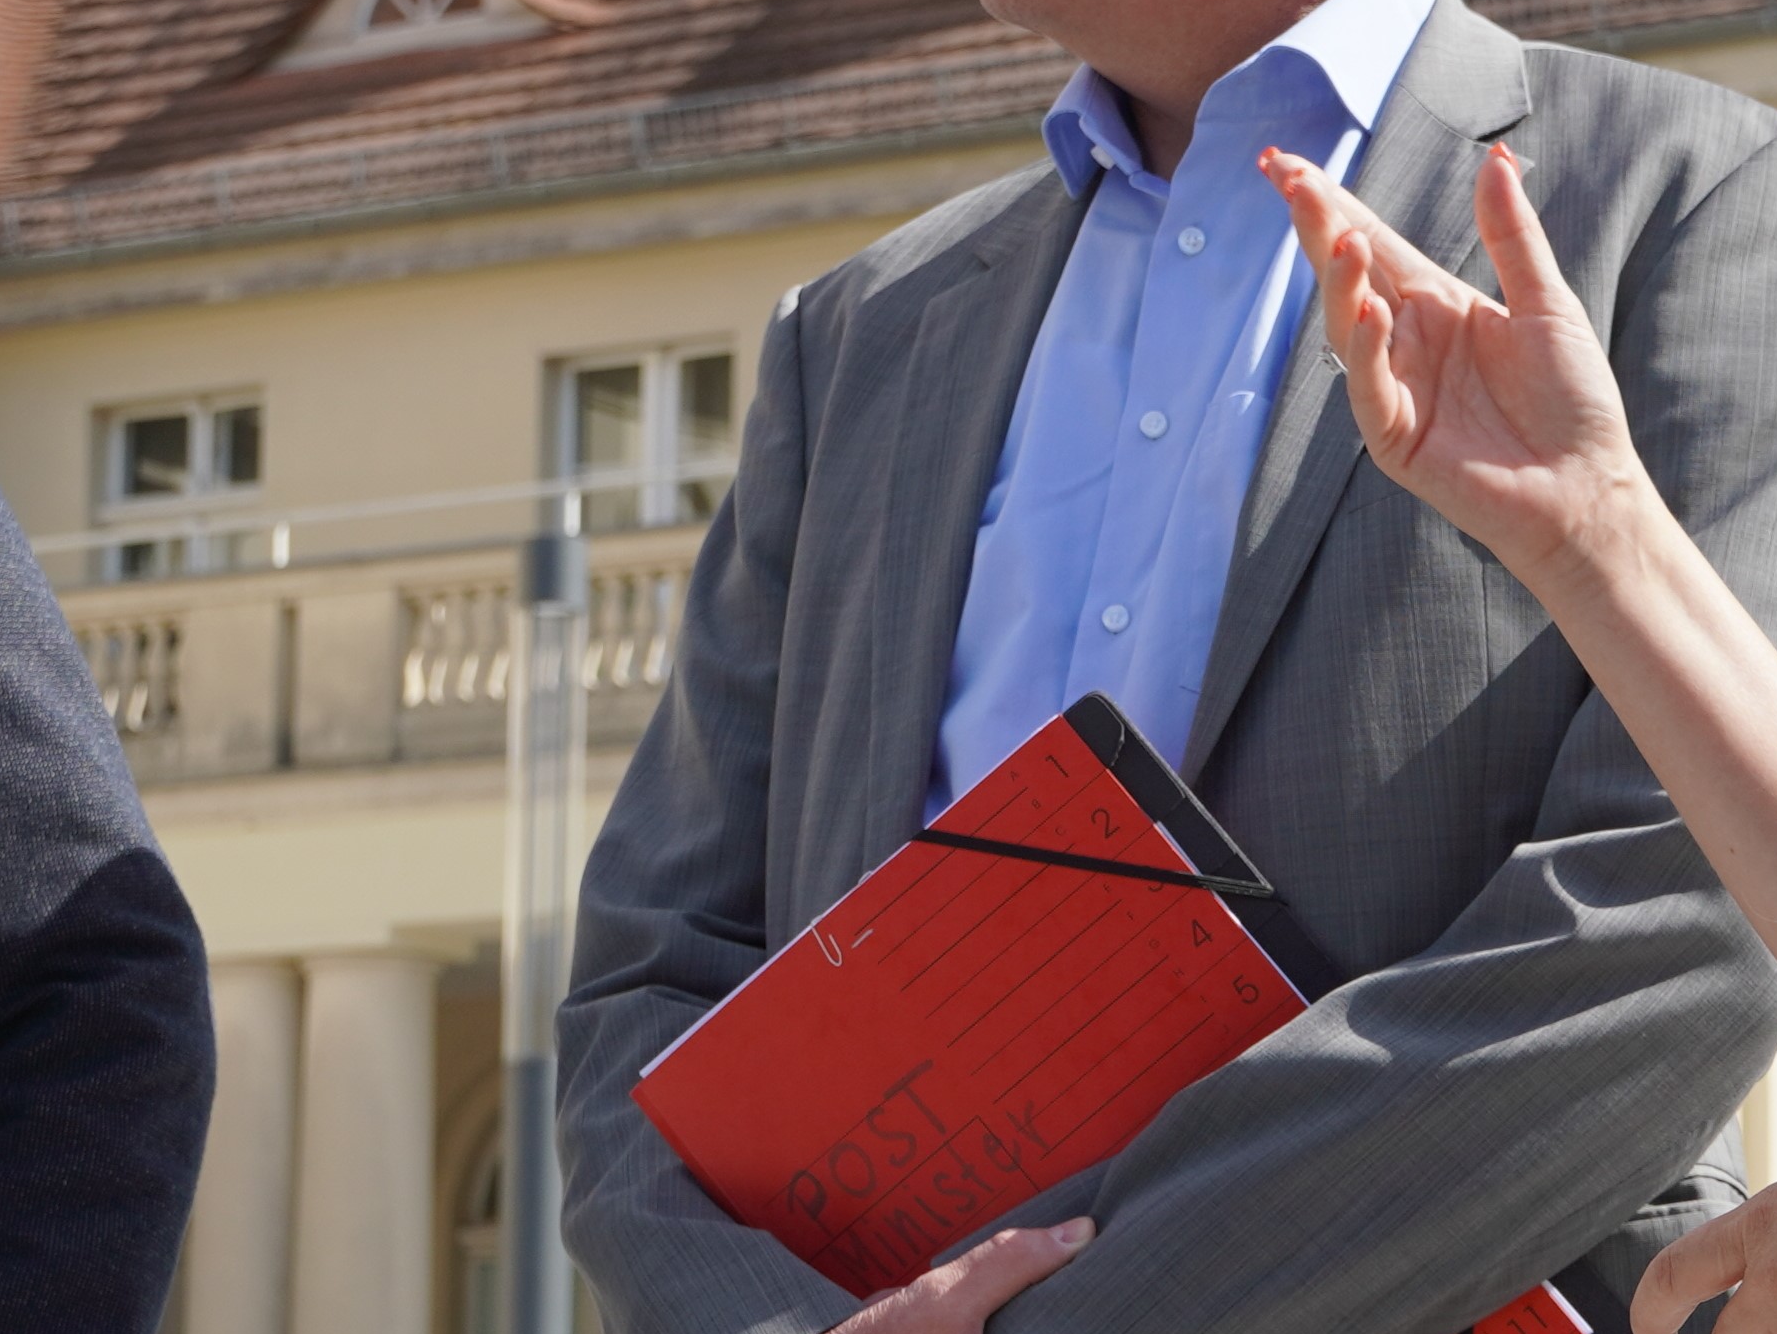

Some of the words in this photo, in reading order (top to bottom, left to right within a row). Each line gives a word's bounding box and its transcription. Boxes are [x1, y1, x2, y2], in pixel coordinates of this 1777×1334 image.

[1045, 754, 1070, 779] 1
[1090, 807, 1121, 839] 2
[1190, 919, 1214, 948] 4
[1232, 974, 1260, 1005] 5
[786, 1058, 948, 1237] POST
